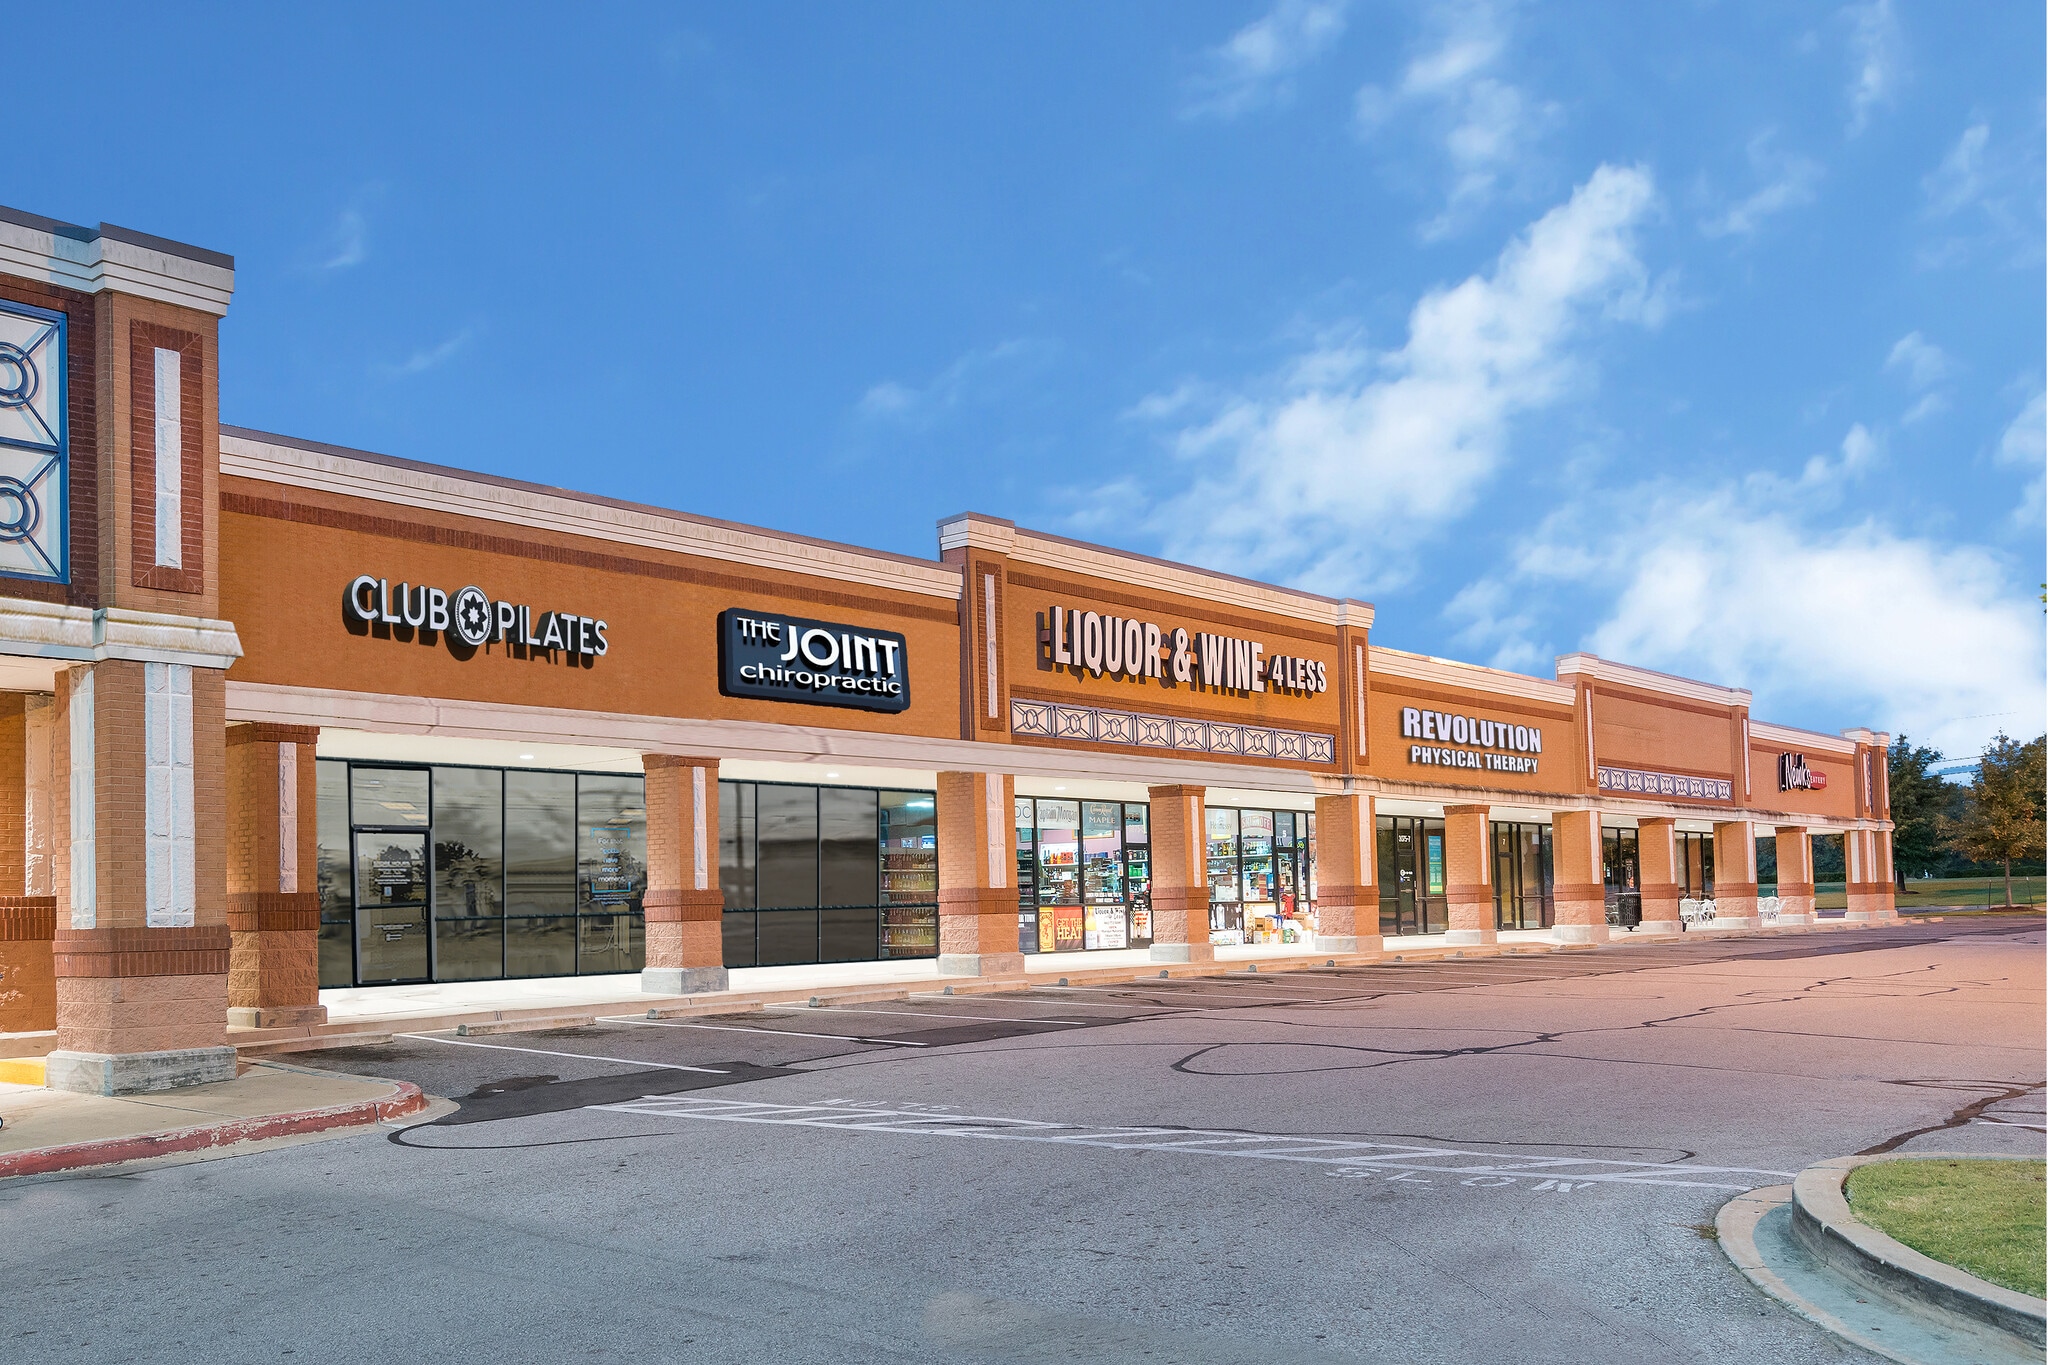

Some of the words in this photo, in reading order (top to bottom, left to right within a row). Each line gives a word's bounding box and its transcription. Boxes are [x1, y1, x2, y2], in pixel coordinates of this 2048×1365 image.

[350, 574, 450, 631] CLUB
[497, 601, 609, 657] PILATES
[736, 617, 782, 642] THE
[780, 625, 899, 676] JOINT
[1053, 605, 1162, 677] LIQUOR
[1172, 627, 1193, 683] &
[1199, 631, 1265, 693] WINE
[739, 662, 902, 694] chiropractic
[1402, 706, 1542, 753] REVOLUTION
[1410, 745, 1482, 769] PHYSICAL
[1485, 753, 1538, 773] THERAPY
[1088, 816, 1115, 824] MAPLE
[1282, 829, 1288, 838] 5
[1502, 838, 1506, 846] 7
[1056, 918, 1070, 927] GET
[1071, 917, 1083, 927] THE
[1056, 926, 1083, 940] HEAT
[1324, 1166, 1598, 1193] SLOW
